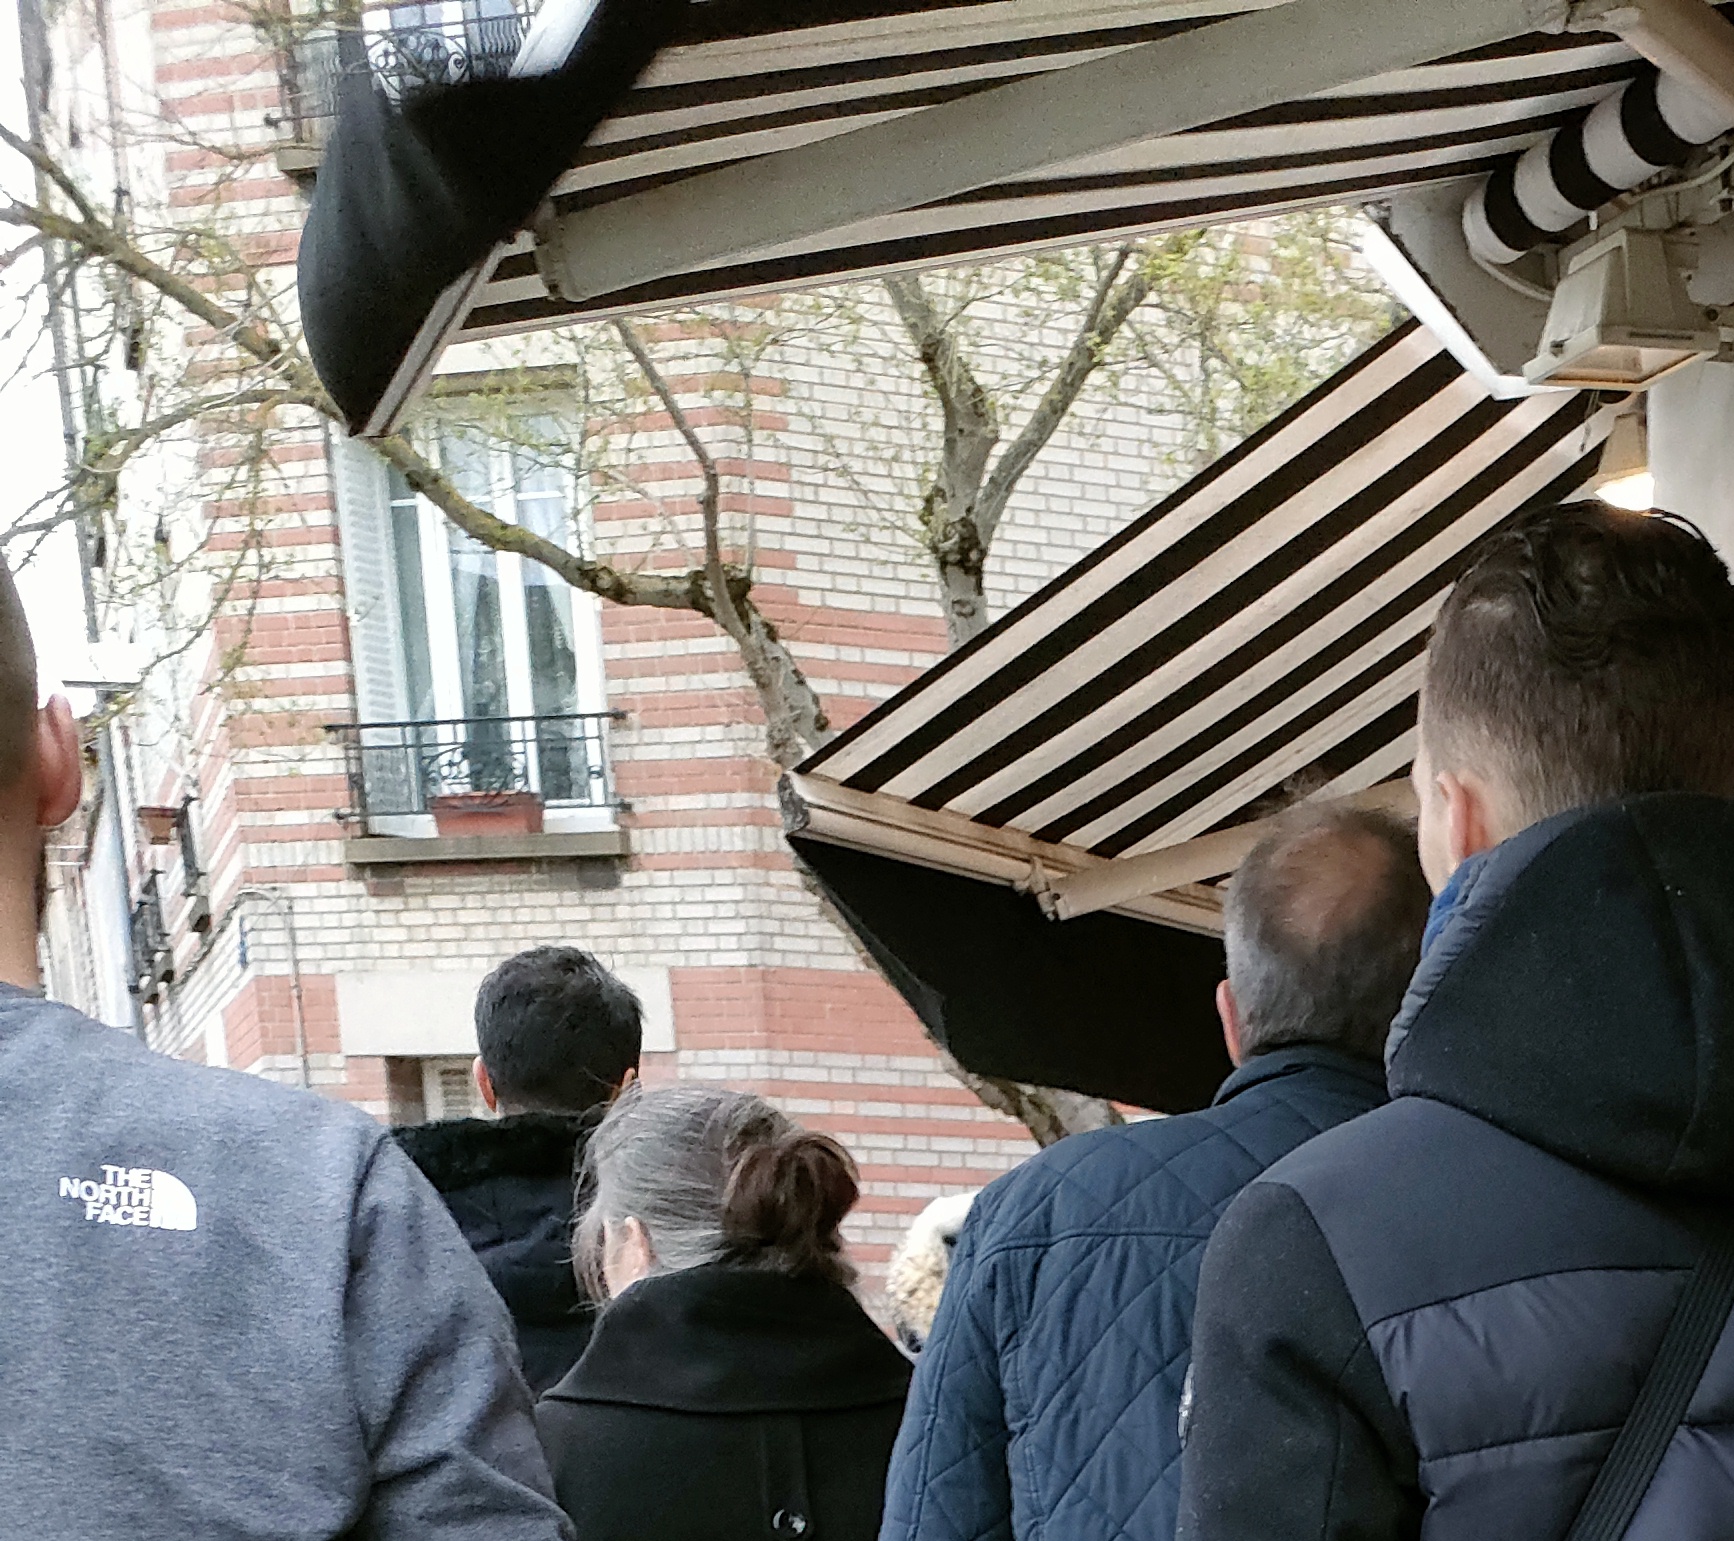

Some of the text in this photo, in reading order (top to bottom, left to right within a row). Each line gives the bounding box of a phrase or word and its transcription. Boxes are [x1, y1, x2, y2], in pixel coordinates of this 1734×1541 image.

[101, 1164, 151, 1187] THE
[59, 1176, 150, 1207] NORTH
[86, 1201, 150, 1226] FACE
